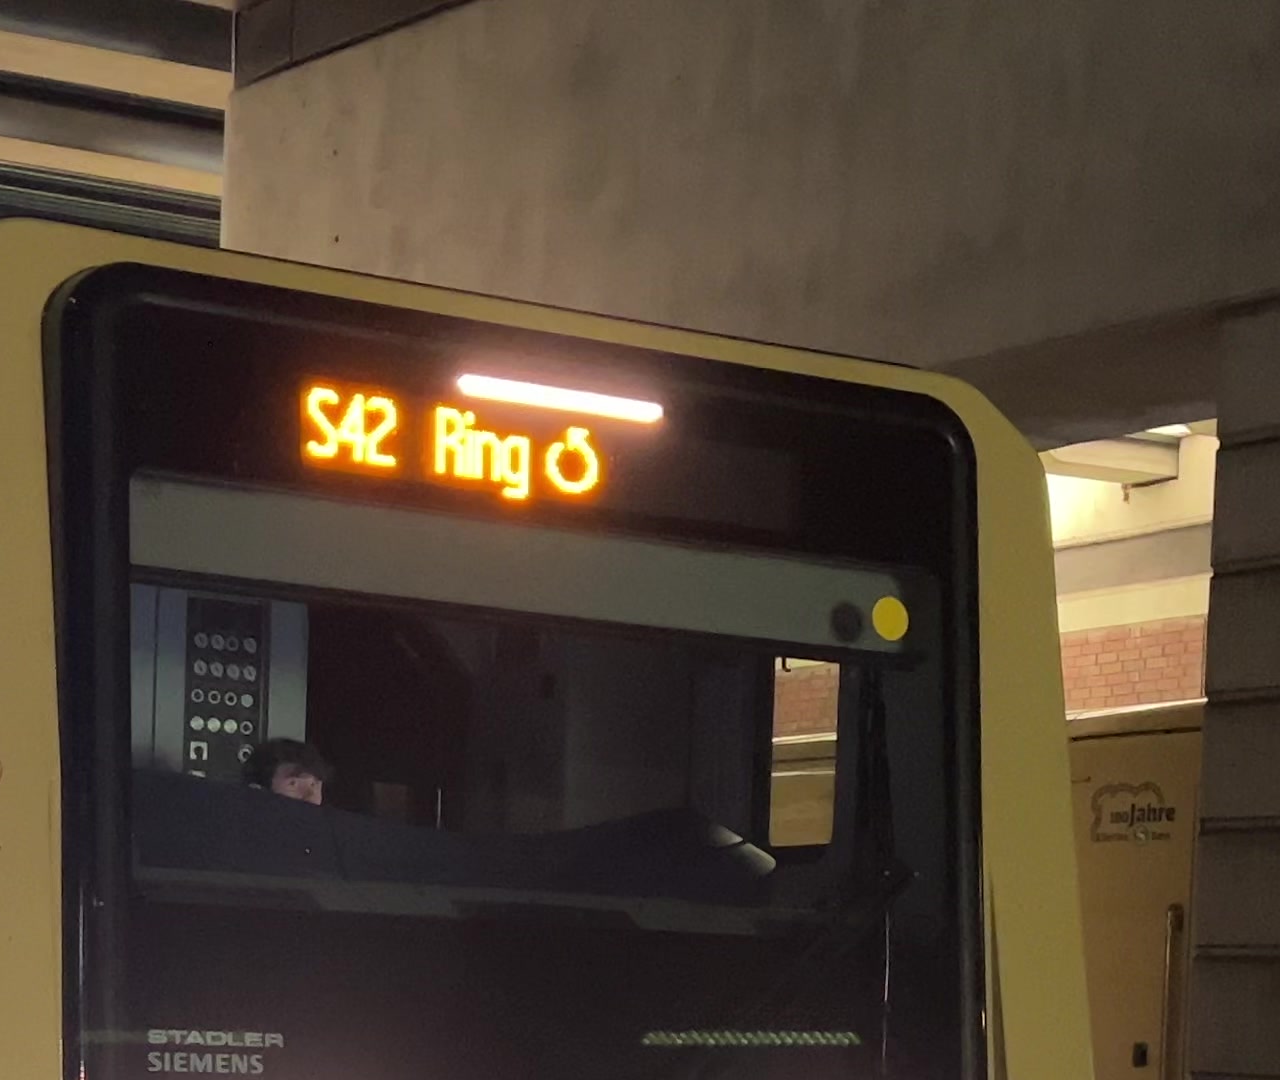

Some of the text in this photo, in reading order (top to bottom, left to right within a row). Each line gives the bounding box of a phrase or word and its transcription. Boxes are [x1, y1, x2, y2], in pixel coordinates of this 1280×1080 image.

[306, 387, 530, 499] S42 Ring
[147, 1029, 284, 1048] STADLER
[147, 1052, 264, 1074] SIEMENS
